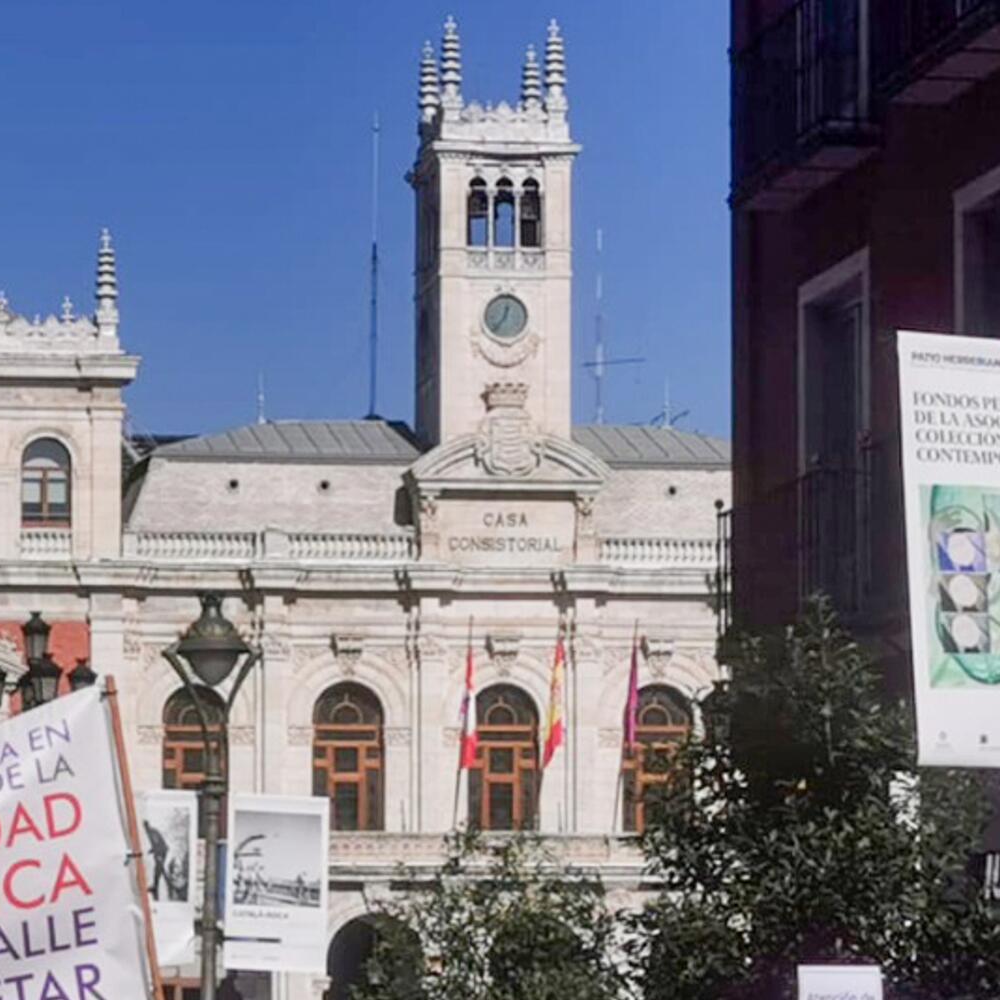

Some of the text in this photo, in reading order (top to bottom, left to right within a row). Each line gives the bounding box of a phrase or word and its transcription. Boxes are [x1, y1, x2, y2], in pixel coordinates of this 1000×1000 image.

[913, 391, 980, 408] FONDOS
[483, 512, 528, 528] CASA
[449, 537, 562, 552] CONSISTORIAL
[28, 719, 72, 751] EN
[35, 754, 75, 783] LA
